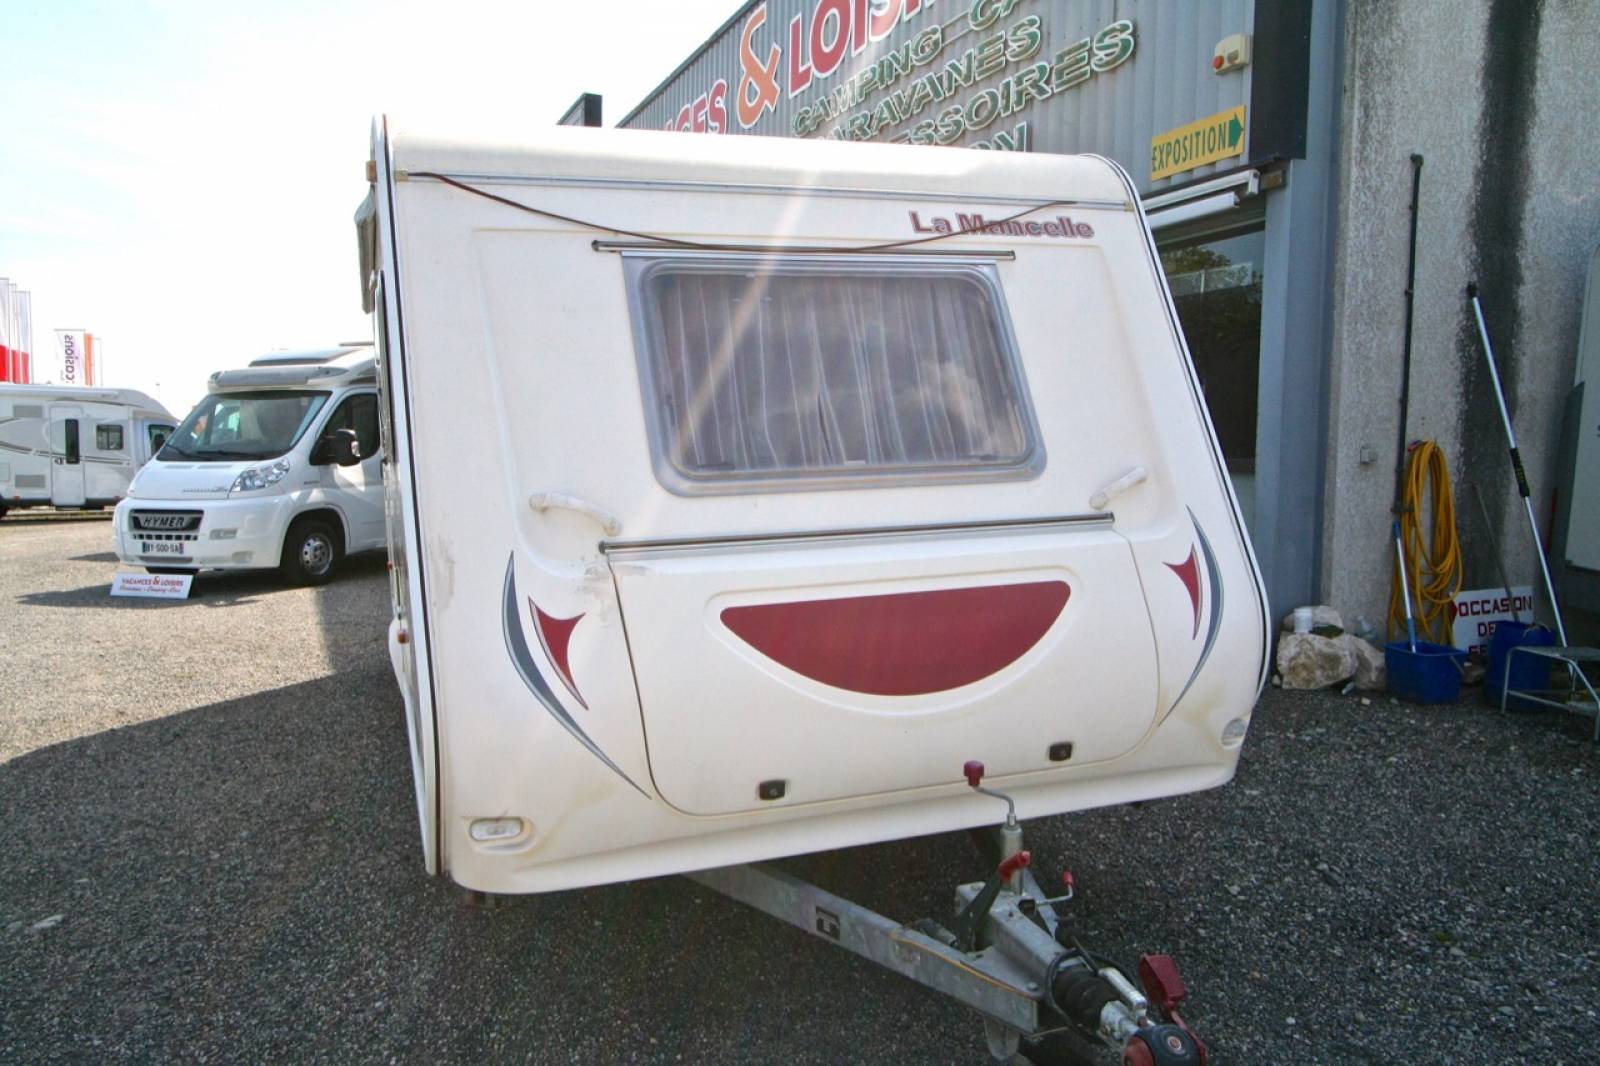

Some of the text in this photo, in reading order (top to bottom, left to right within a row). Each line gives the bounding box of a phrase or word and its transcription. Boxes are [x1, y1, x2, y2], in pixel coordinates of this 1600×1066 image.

[791, 24, 942, 137] CAMPING
[1152, 121, 1226, 172] EXPOSITION
[909, 210, 1096, 240] La Mancelle
[143, 516, 185, 528] HYMER
[1458, 596, 1532, 617] OCCASON
